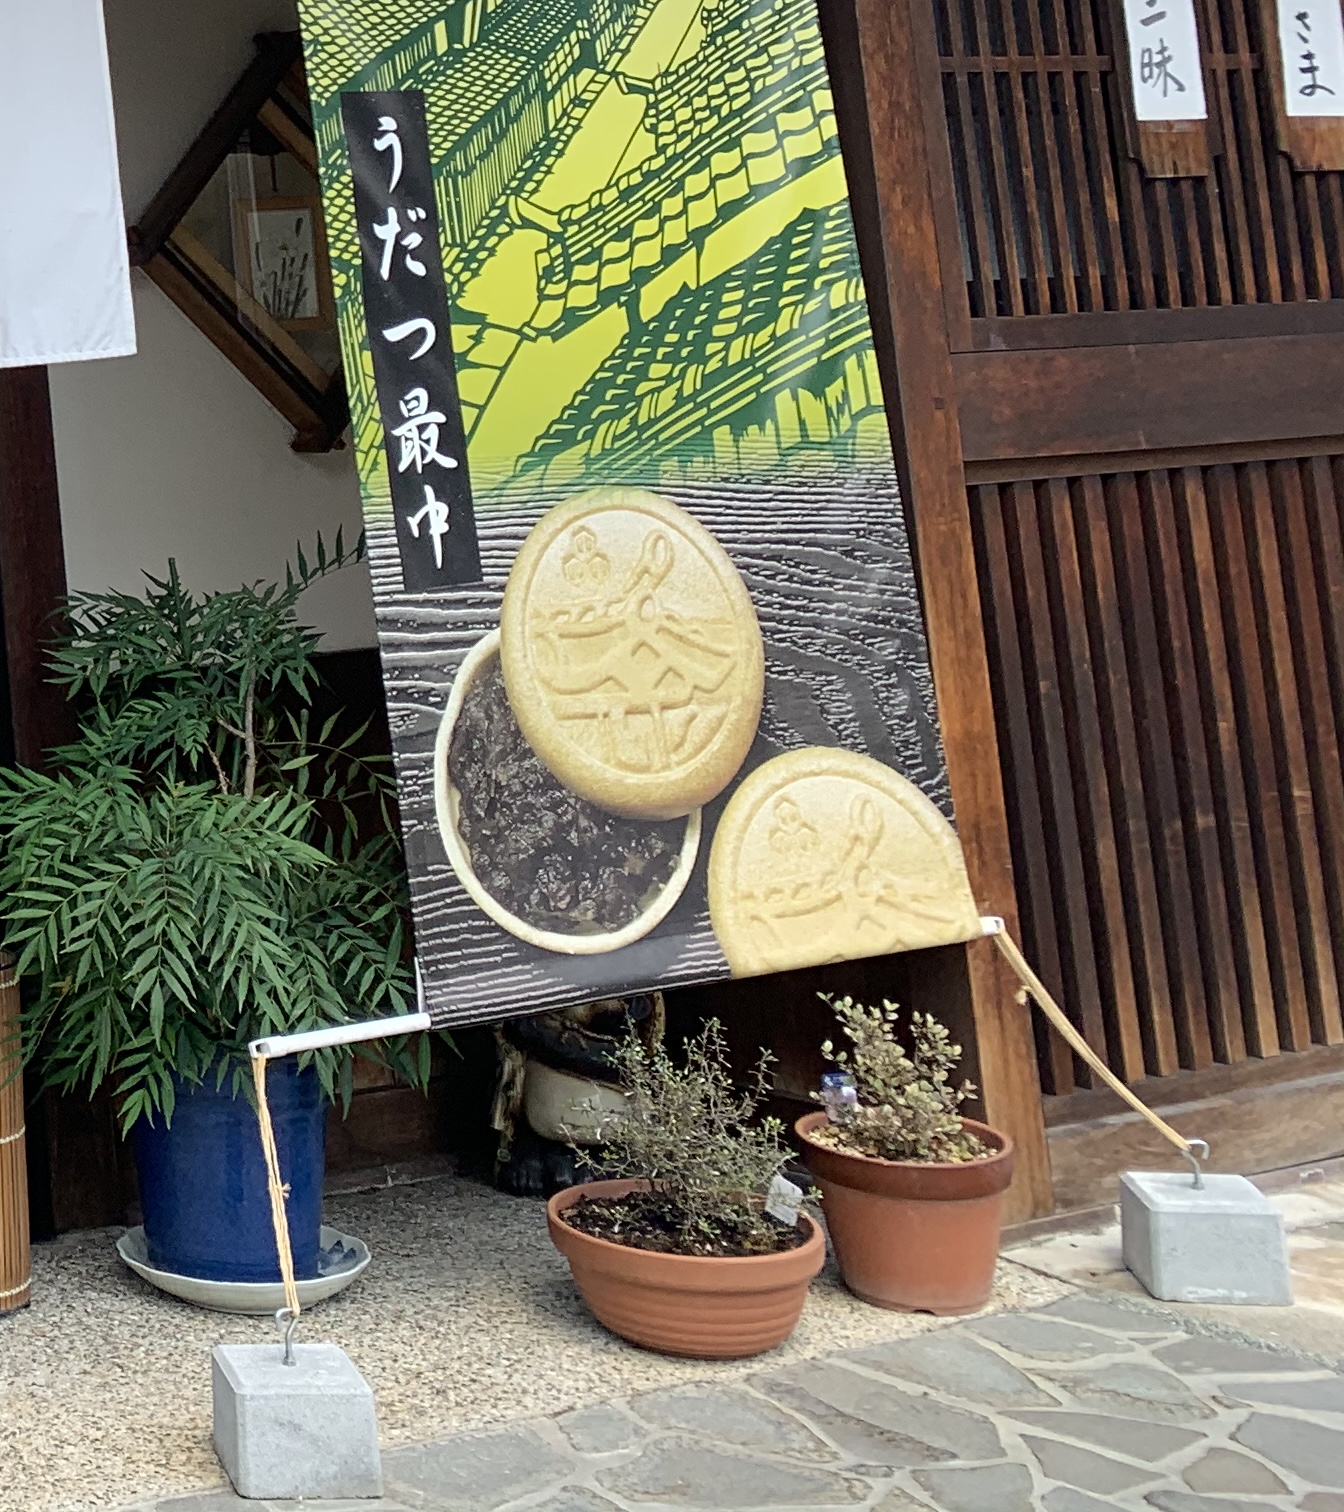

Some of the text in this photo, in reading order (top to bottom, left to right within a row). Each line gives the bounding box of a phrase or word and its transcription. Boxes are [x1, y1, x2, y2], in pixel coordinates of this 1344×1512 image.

[372, 116, 459, 570] うだつ最中
